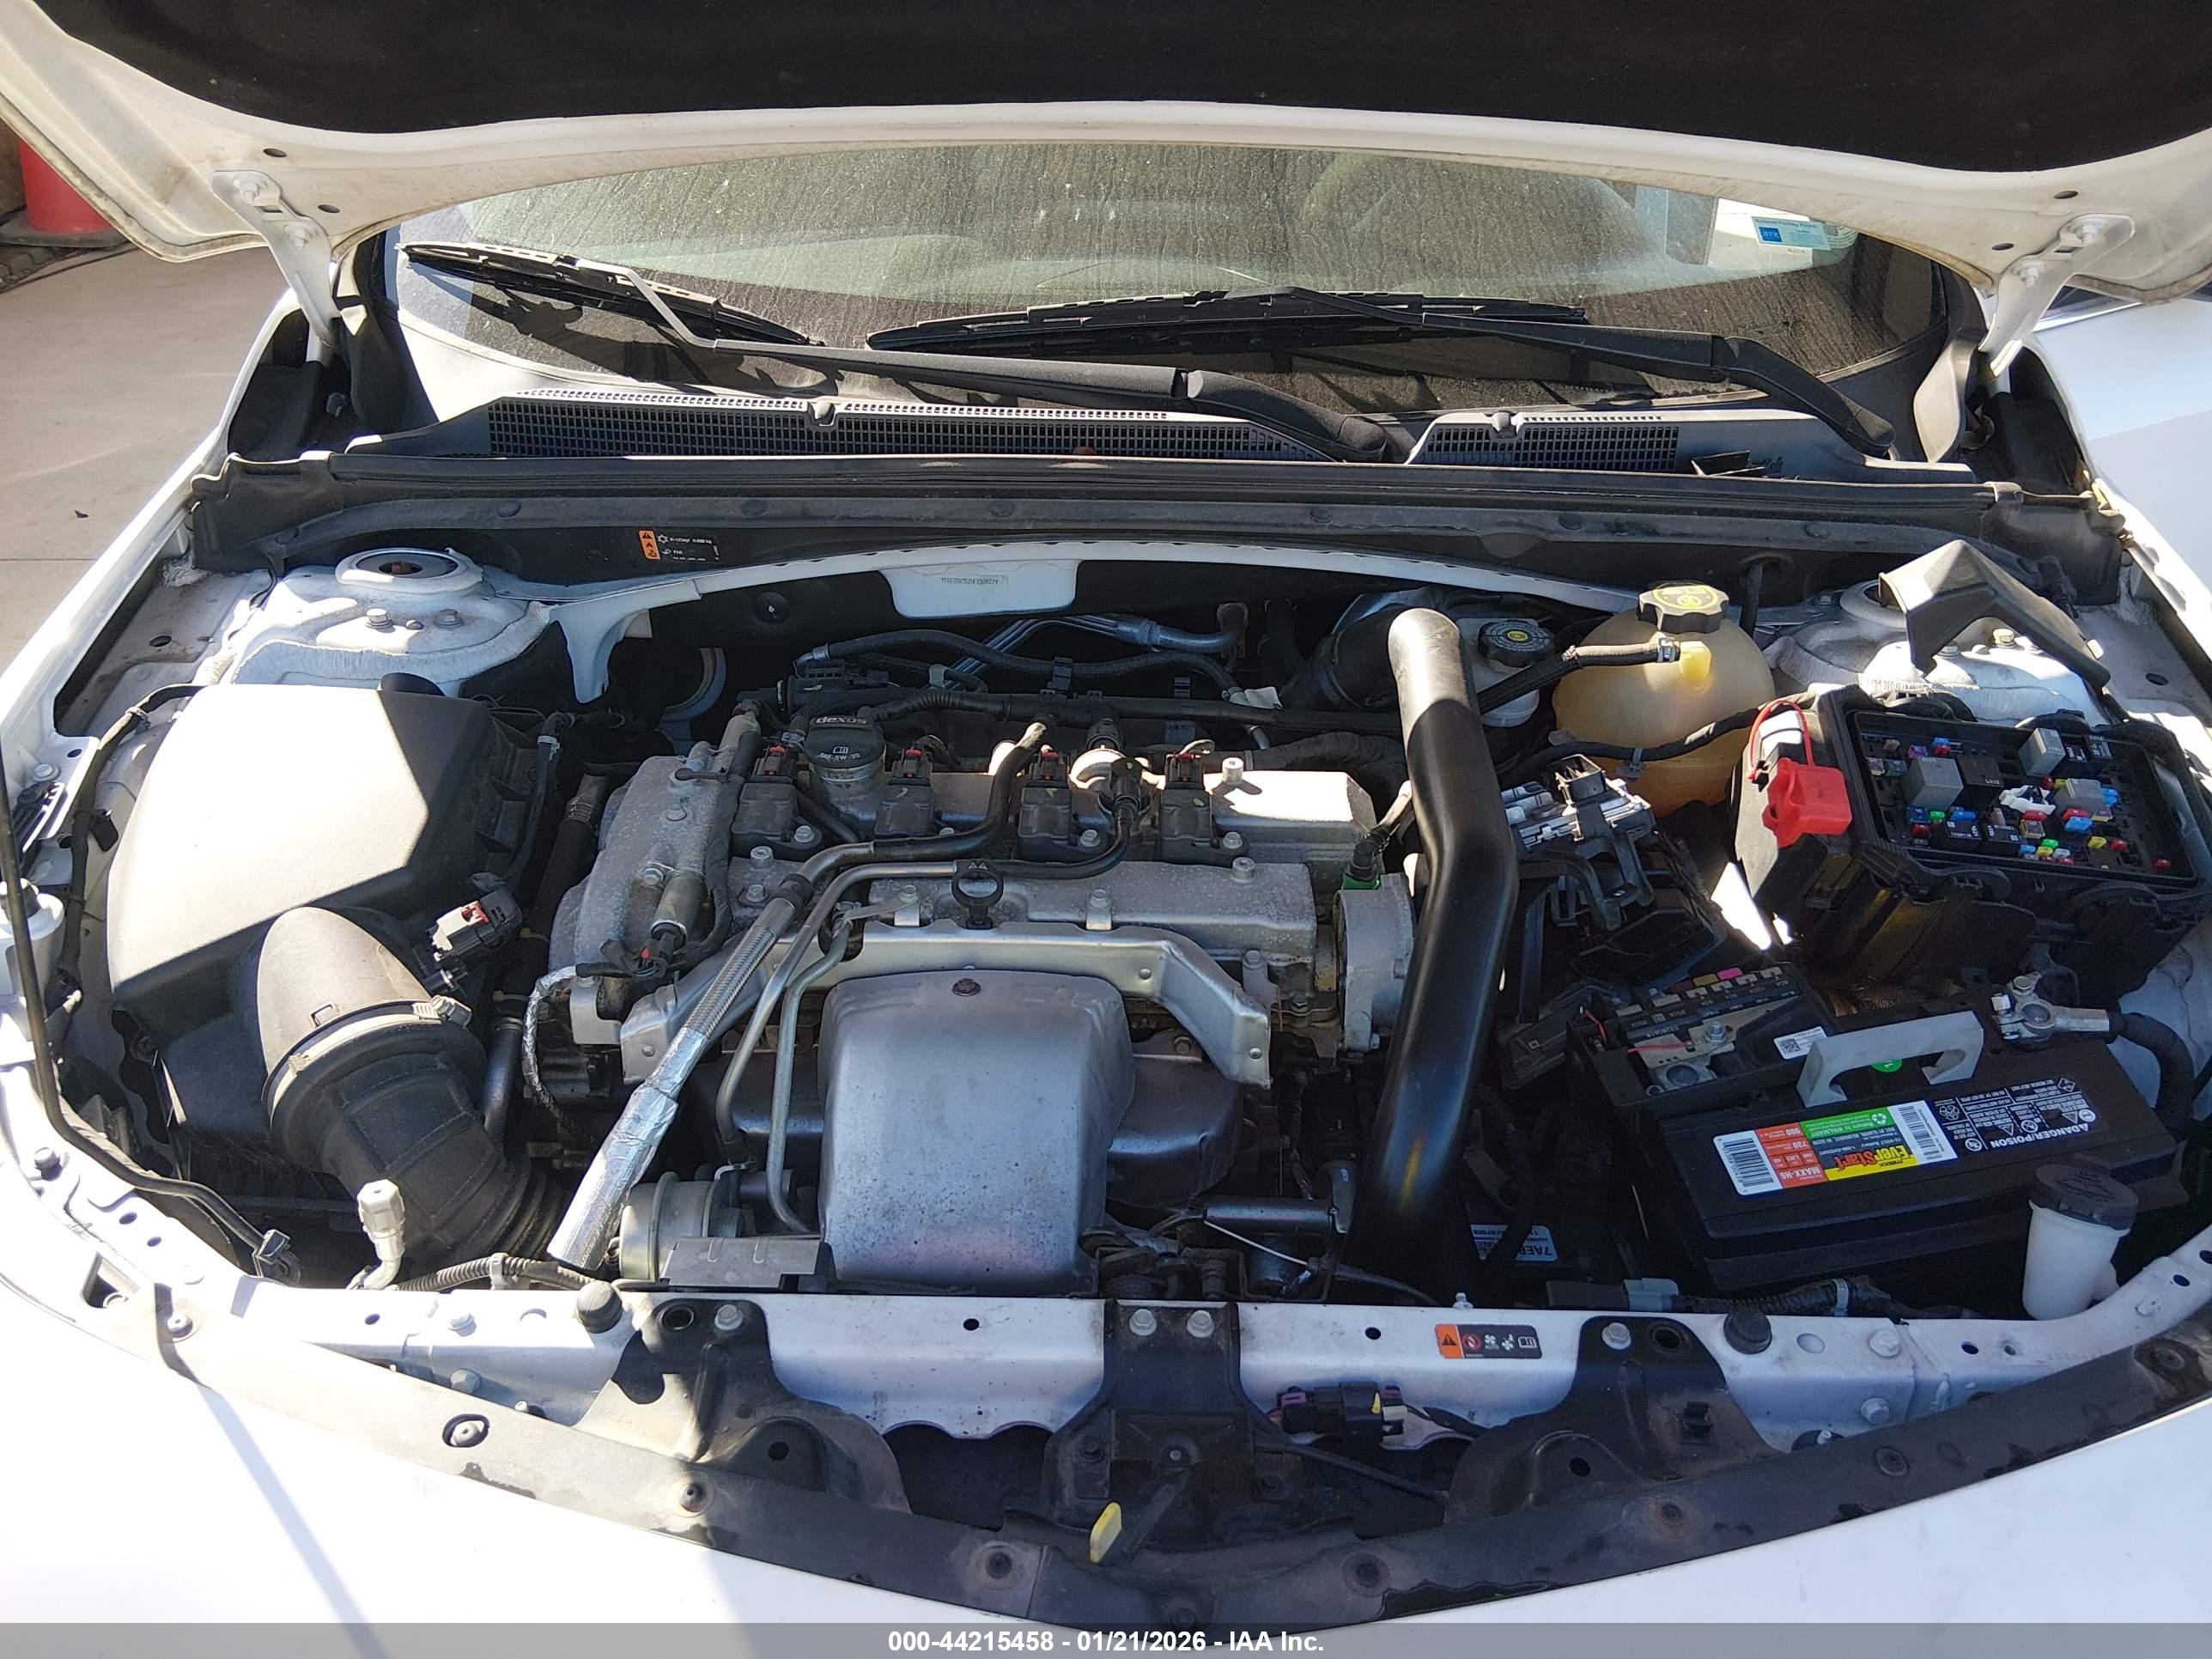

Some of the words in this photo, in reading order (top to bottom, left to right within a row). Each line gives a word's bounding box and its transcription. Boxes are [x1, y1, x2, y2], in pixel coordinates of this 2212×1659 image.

[1851, 1121, 1874, 1129] Return
[1785, 1127, 1800, 1135] 900
[1810, 1127, 1842, 1137] WALMART
[1990, 1125, 2080, 1147] DANGER/POISON
[1832, 1144, 1909, 1170] EverStart
[1779, 1166, 1820, 1179] MAXX-H6
